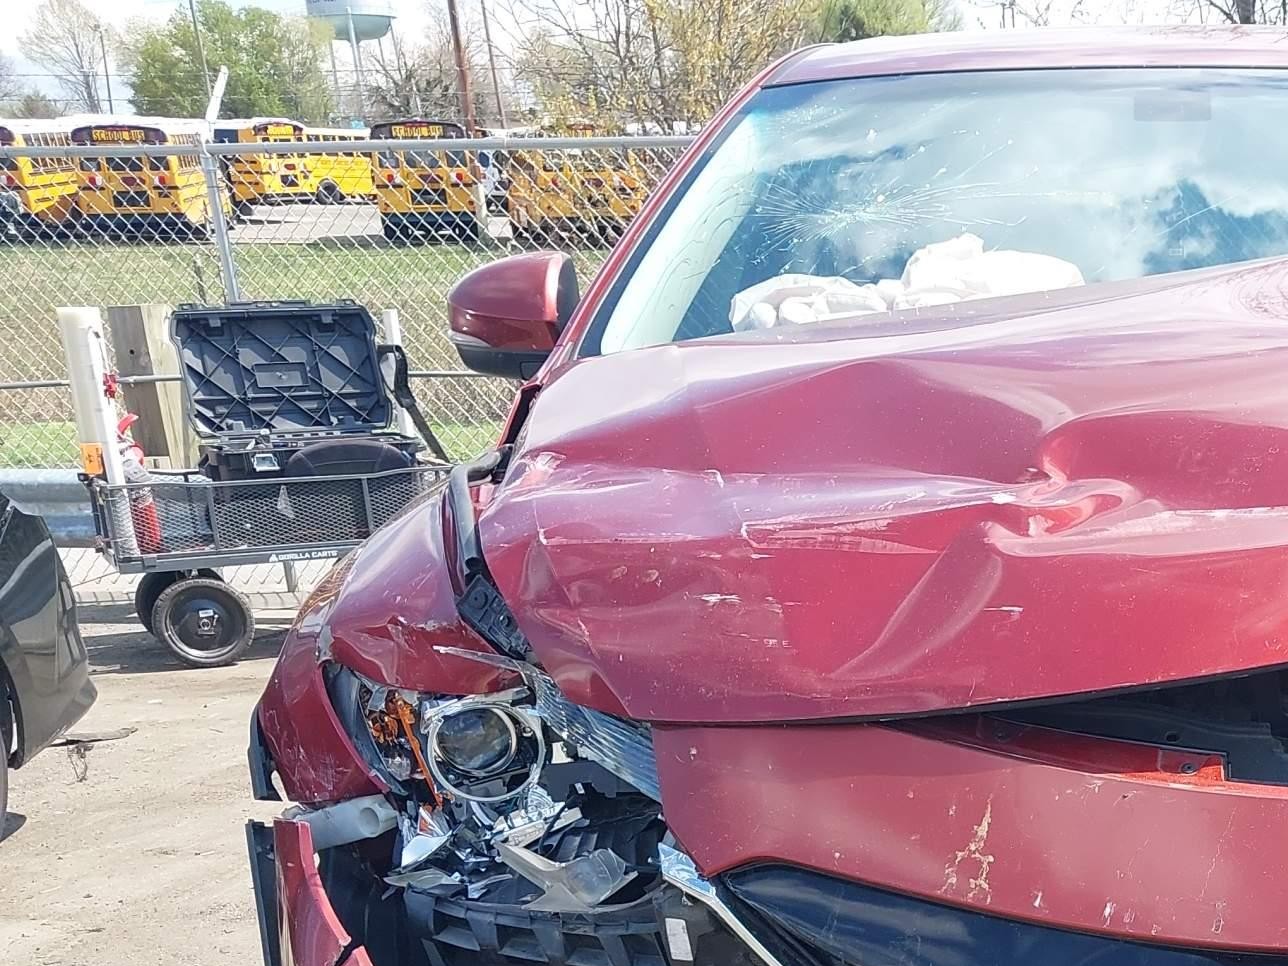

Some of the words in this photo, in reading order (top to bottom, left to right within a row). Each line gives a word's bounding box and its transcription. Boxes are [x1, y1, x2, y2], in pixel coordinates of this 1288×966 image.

[93, 130, 124, 140] SCHOOL
[128, 130, 144, 140] BUS
[311, 550, 338, 558] CARTS
